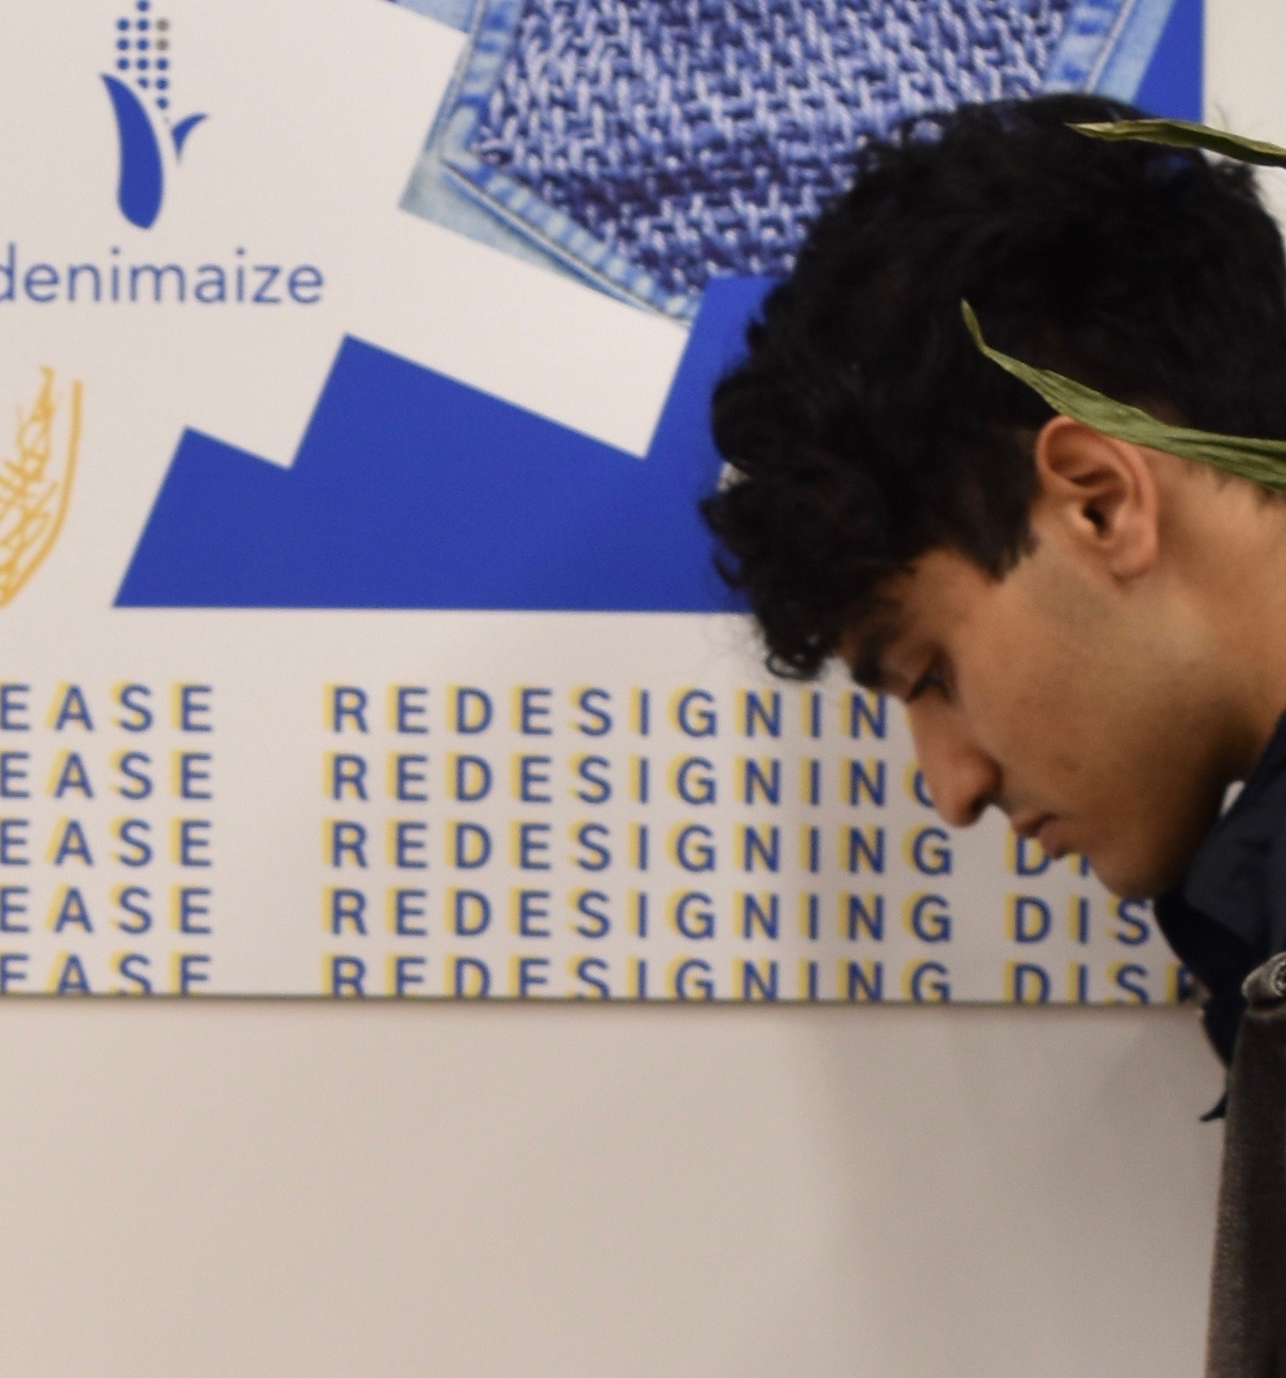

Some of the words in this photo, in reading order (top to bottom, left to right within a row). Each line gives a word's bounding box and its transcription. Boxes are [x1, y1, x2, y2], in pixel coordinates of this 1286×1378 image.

[322, 682, 888, 740] REDESIGNIN
[321, 816, 953, 875] REDESIGNING
[320, 883, 952, 943] REDESIGNING
